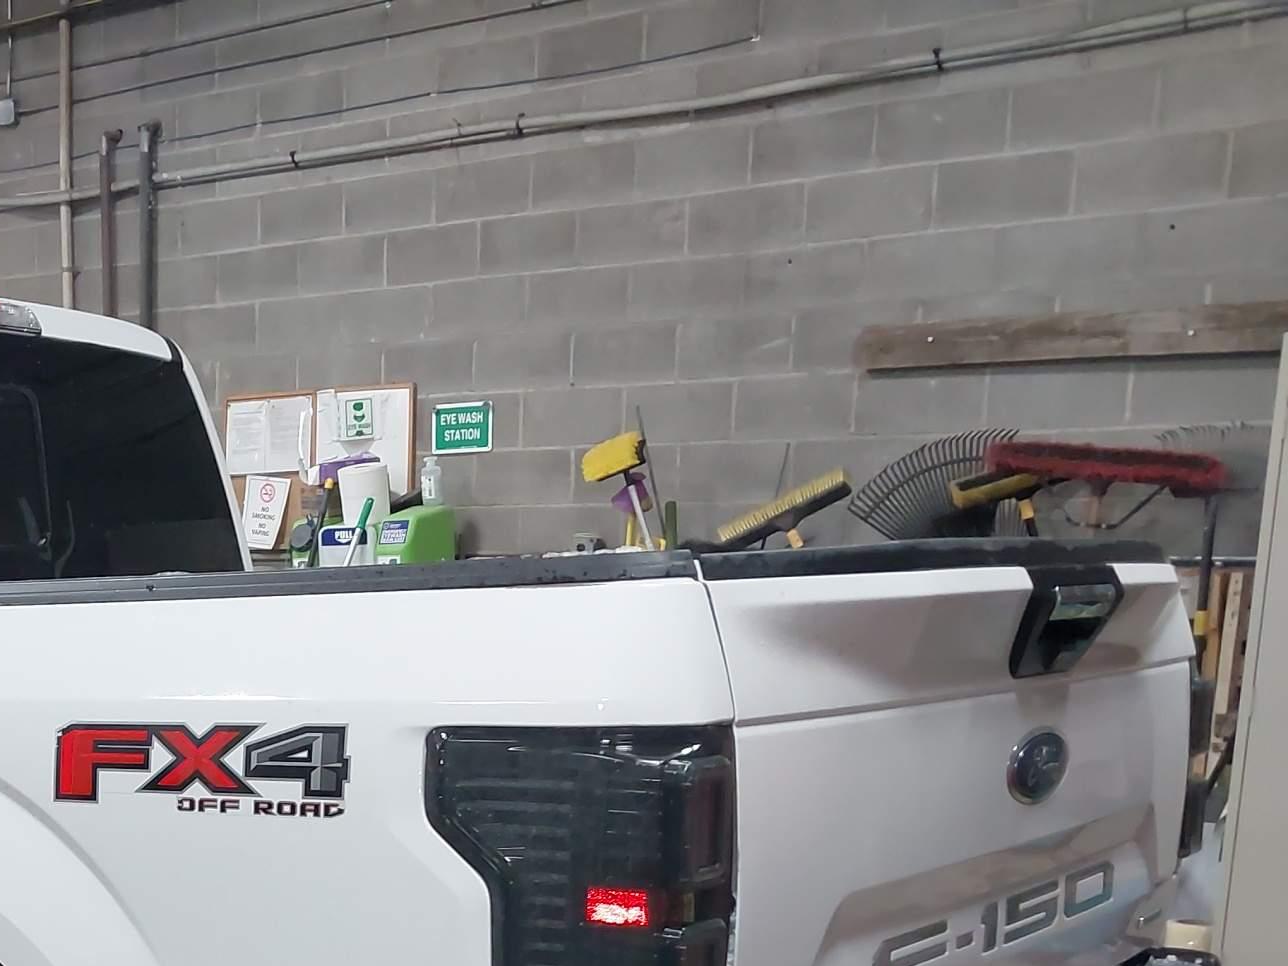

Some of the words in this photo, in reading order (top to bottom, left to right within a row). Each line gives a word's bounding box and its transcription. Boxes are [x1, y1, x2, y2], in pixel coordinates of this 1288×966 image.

[440, 413, 457, 425] EYE
[458, 411, 484, 424] WASH
[444, 428, 481, 441] STATION
[334, 530, 354, 539] PULL
[53, 720, 351, 803] FX4
[177, 797, 240, 813] OFF
[253, 800, 345, 818] ROAD
